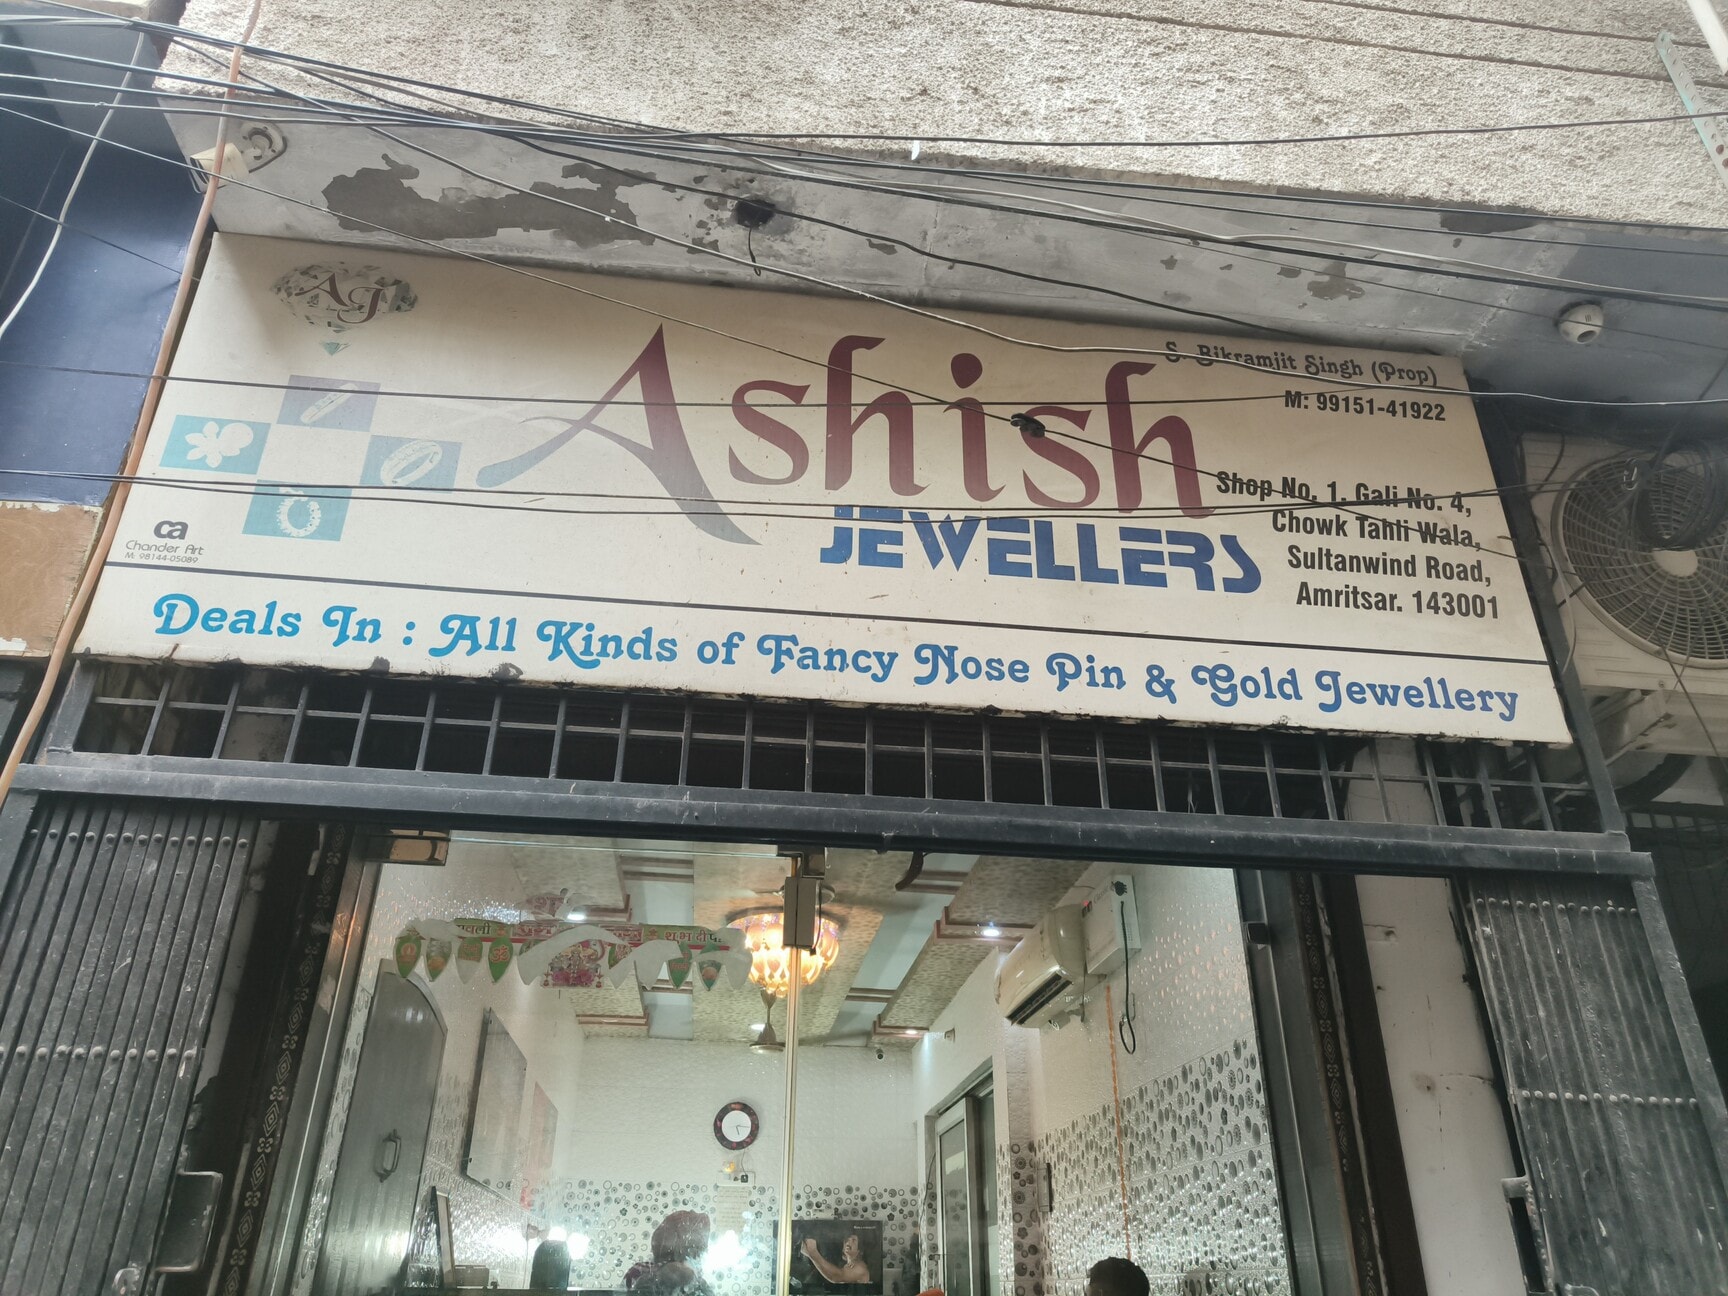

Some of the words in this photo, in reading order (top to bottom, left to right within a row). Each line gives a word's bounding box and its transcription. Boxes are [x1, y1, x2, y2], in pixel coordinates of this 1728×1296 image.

[294, 272, 384, 324] AJ
[1196, 344, 1297, 370] Bikramjit
[1304, 353, 1363, 378] Singh
[1371, 360, 1438, 387] (Prop)
[1284, 389, 1309, 410] M:
[1316, 393, 1446, 422] 99151-41922
[475, 322, 1216, 546] Ashish
[1216, 470, 1272, 502] Shop
[1281, 476, 1318, 501] No.
[1355, 482, 1398, 505] Gali
[1407, 486, 1443, 512] No.
[1450, 491, 1472, 518] 4,
[125, 540, 181, 554] Chander
[184, 544, 205, 556] Art
[819, 505, 1262, 594] JEWELLERS
[1272, 508, 1348, 538] Chowk
[1355, 515, 1410, 542] Tahli
[1417, 520, 1481, 552] Wala,
[139, 552, 199, 564] 98144-05089
[1287, 543, 1417, 578] Sultanwind
[1425, 555, 1492, 588] Road,
[1296, 581, 1403, 613] Amritsar.
[1412, 589, 1499, 620] 143001
[153, 592, 301, 638] Deals
[321, 605, 382, 649] In
[403, 621, 417, 647] :
[428, 613, 517, 659] All
[536, 619, 679, 670] Kinds
[696, 631, 746, 666] of
[756, 633, 899, 683] Fancy
[913, 642, 1030, 685] Nose
[1045, 652, 1127, 693] Pin
[1145, 663, 1178, 705] &
[1190, 662, 1304, 708] Gold
[1314, 669, 1520, 723] Jewellery
